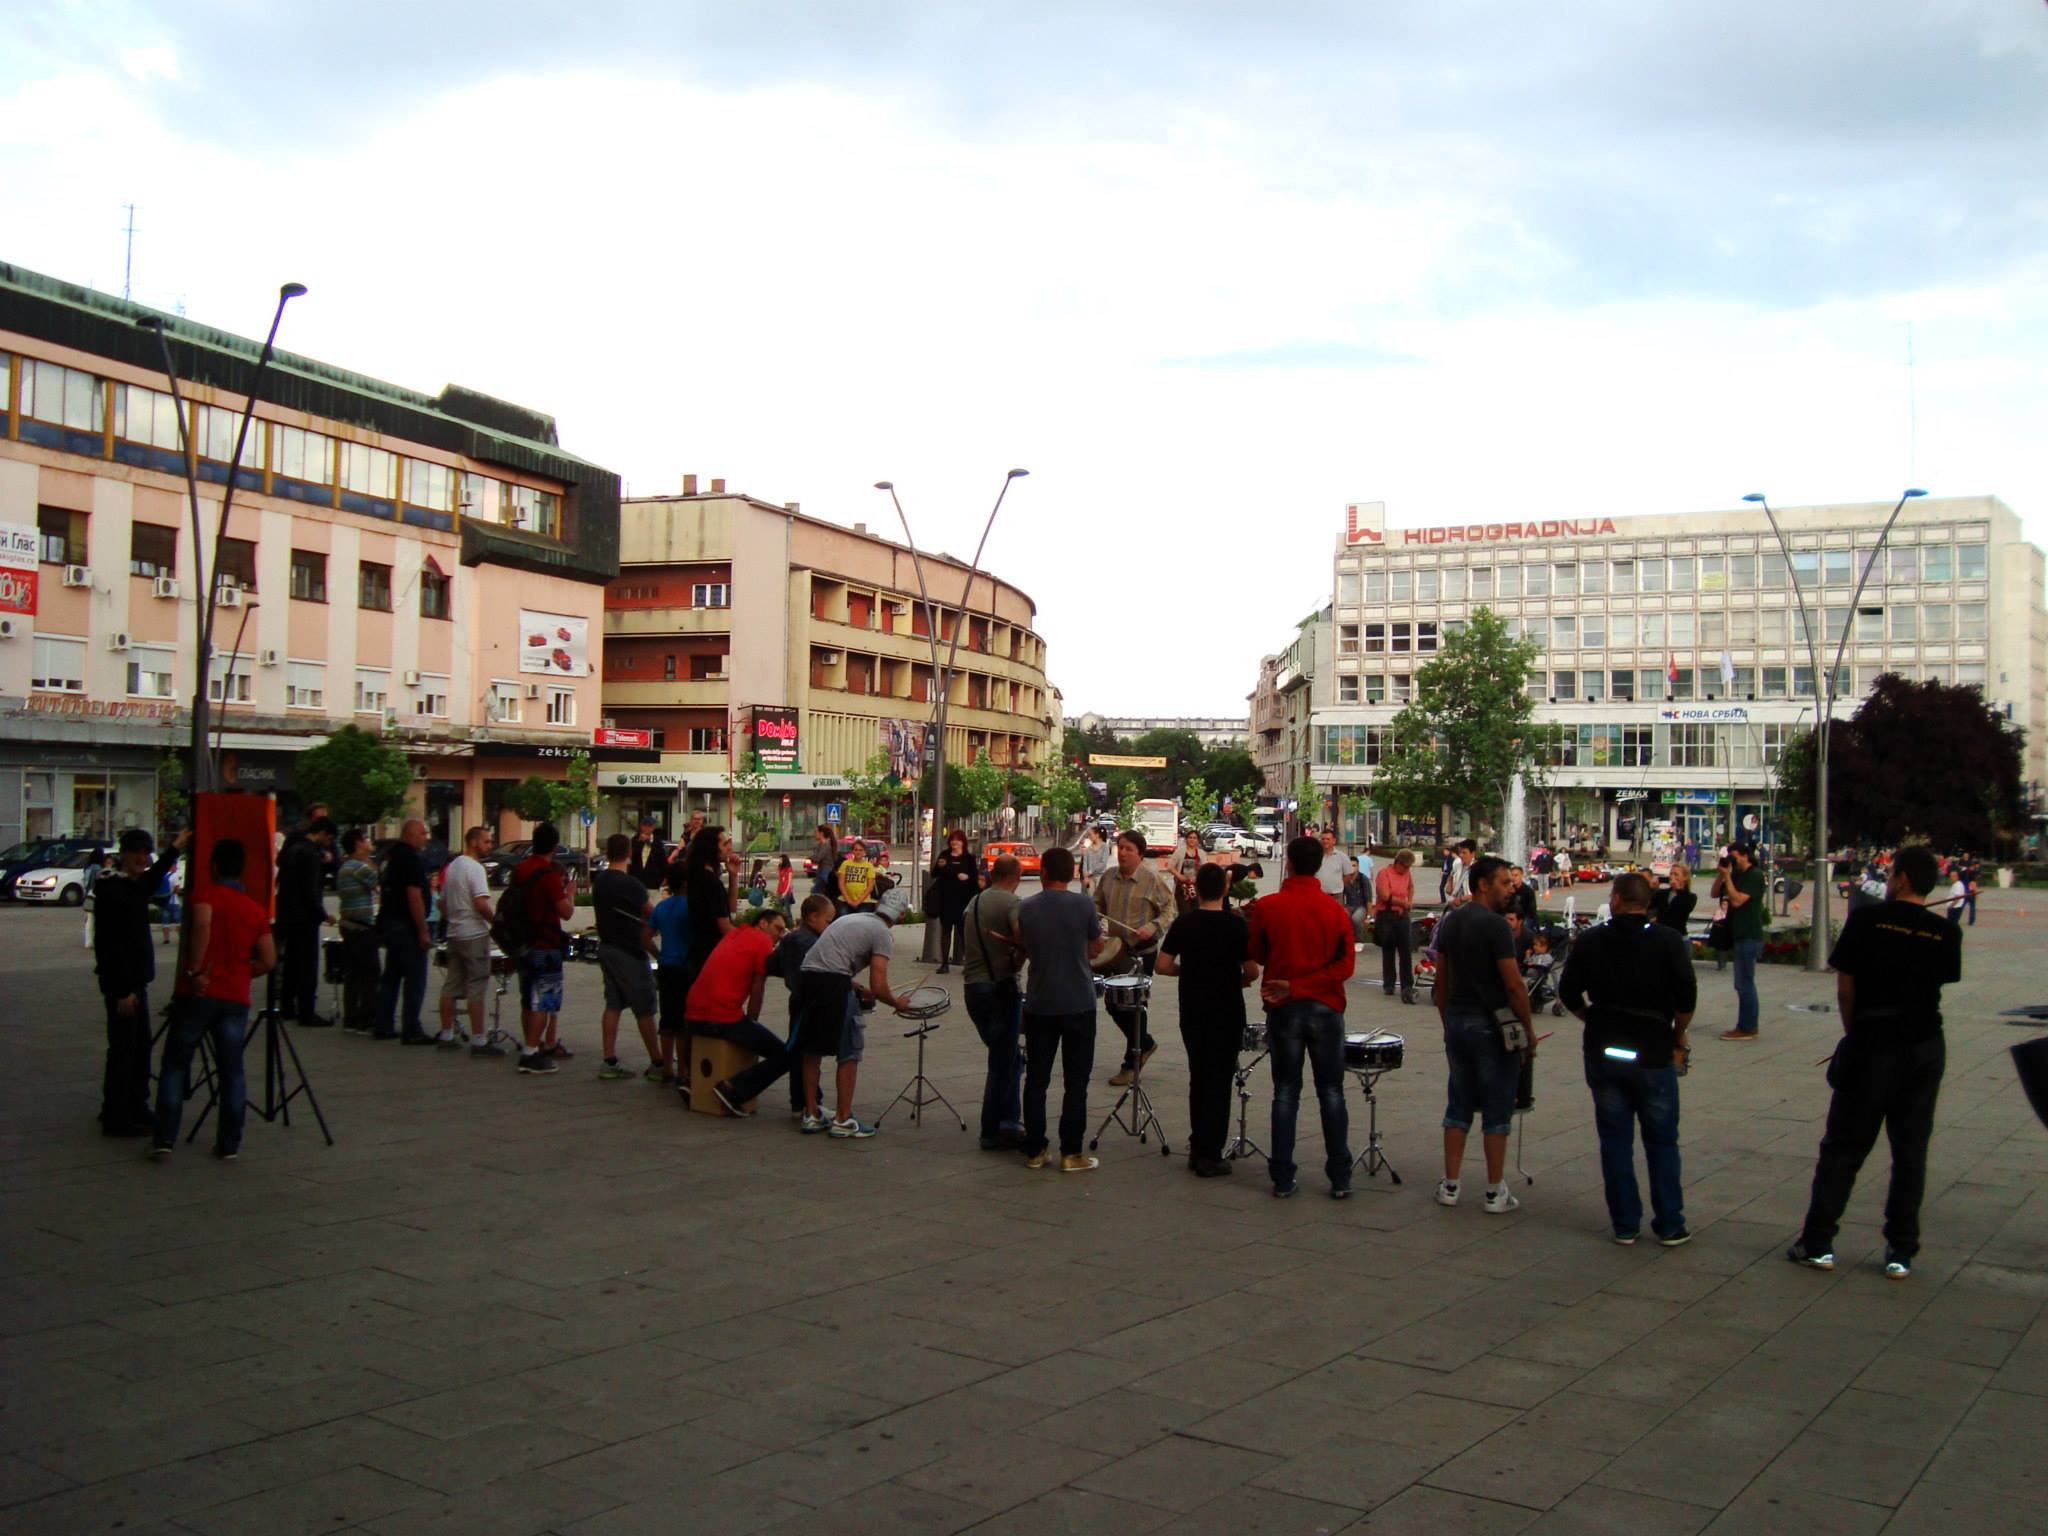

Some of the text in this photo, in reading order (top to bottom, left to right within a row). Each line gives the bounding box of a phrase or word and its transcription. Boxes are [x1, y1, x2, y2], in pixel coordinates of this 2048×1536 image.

[1404, 517, 1617, 544] HIDROGRADNJA
[1682, 710, 1710, 719] НОВА
[538, 746, 591, 758] zeksra
[629, 774, 677, 784] SBERBANK
[1615, 789, 1649, 798] ZEMAX
